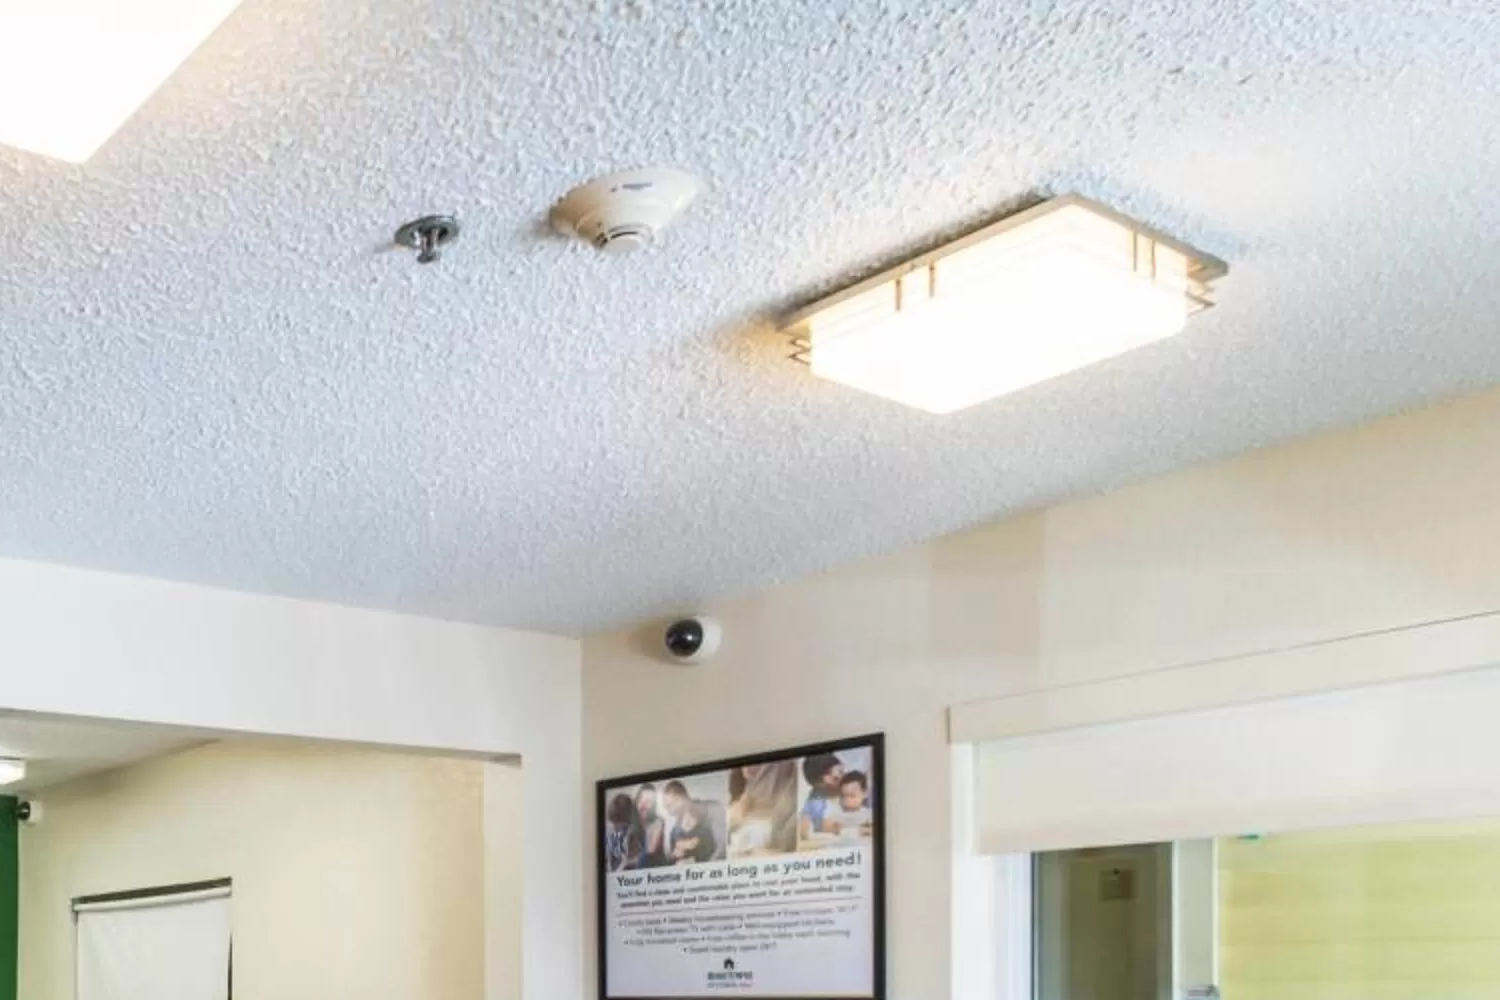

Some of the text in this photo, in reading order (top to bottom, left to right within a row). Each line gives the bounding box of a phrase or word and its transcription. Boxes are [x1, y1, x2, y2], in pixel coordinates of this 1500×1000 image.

[616, 850, 861, 887] Your home for as long as you need!
